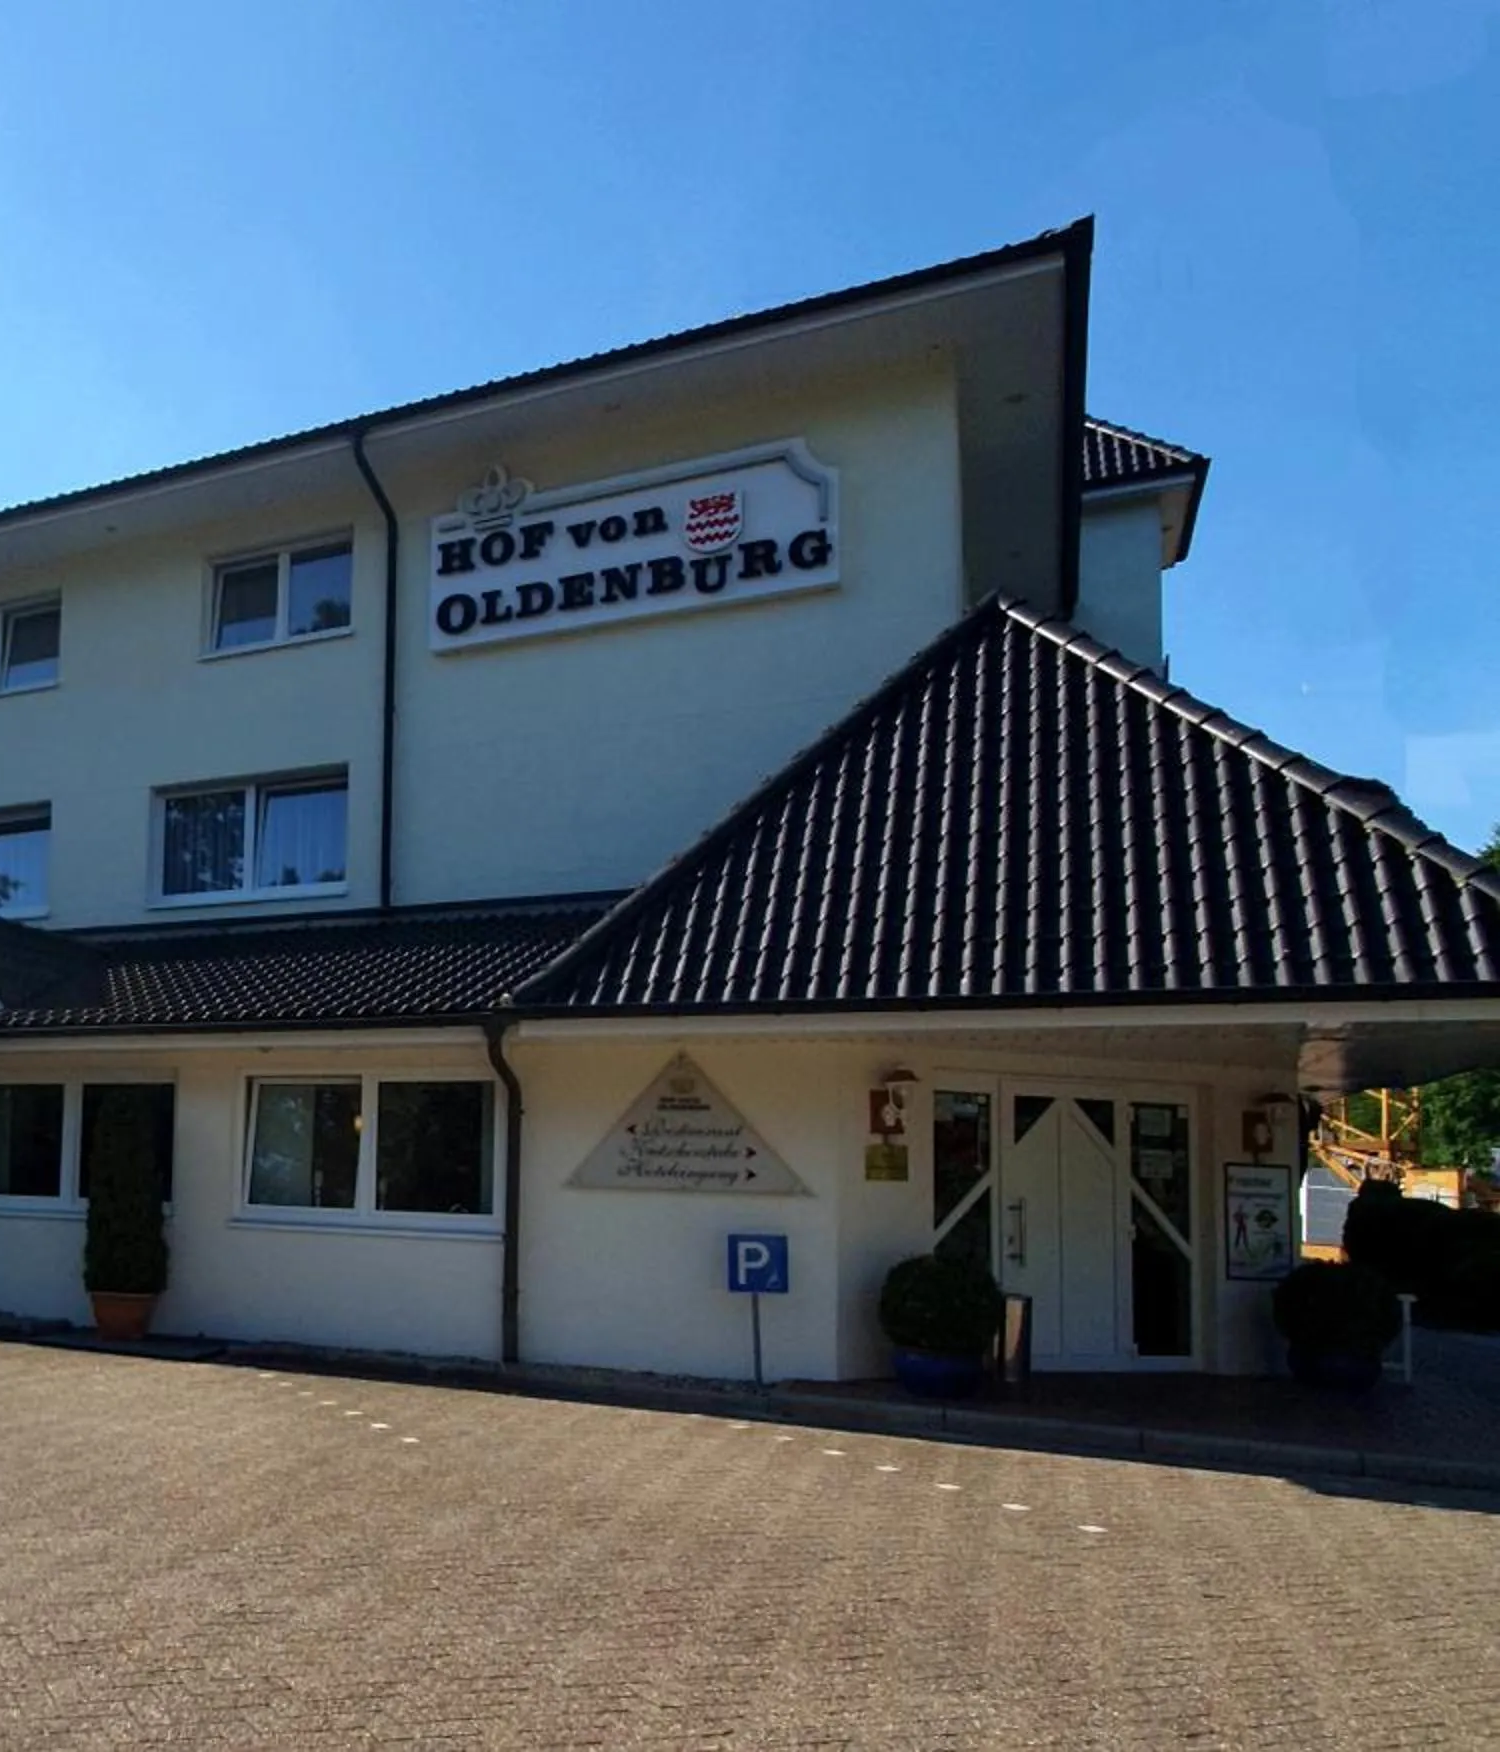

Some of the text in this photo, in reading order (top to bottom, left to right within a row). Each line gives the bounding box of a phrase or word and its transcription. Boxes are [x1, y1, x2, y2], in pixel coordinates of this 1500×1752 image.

[436, 507, 669, 576] HOF von
[436, 529, 833, 635] OLDENBURG
[737, 1241, 769, 1284] P
